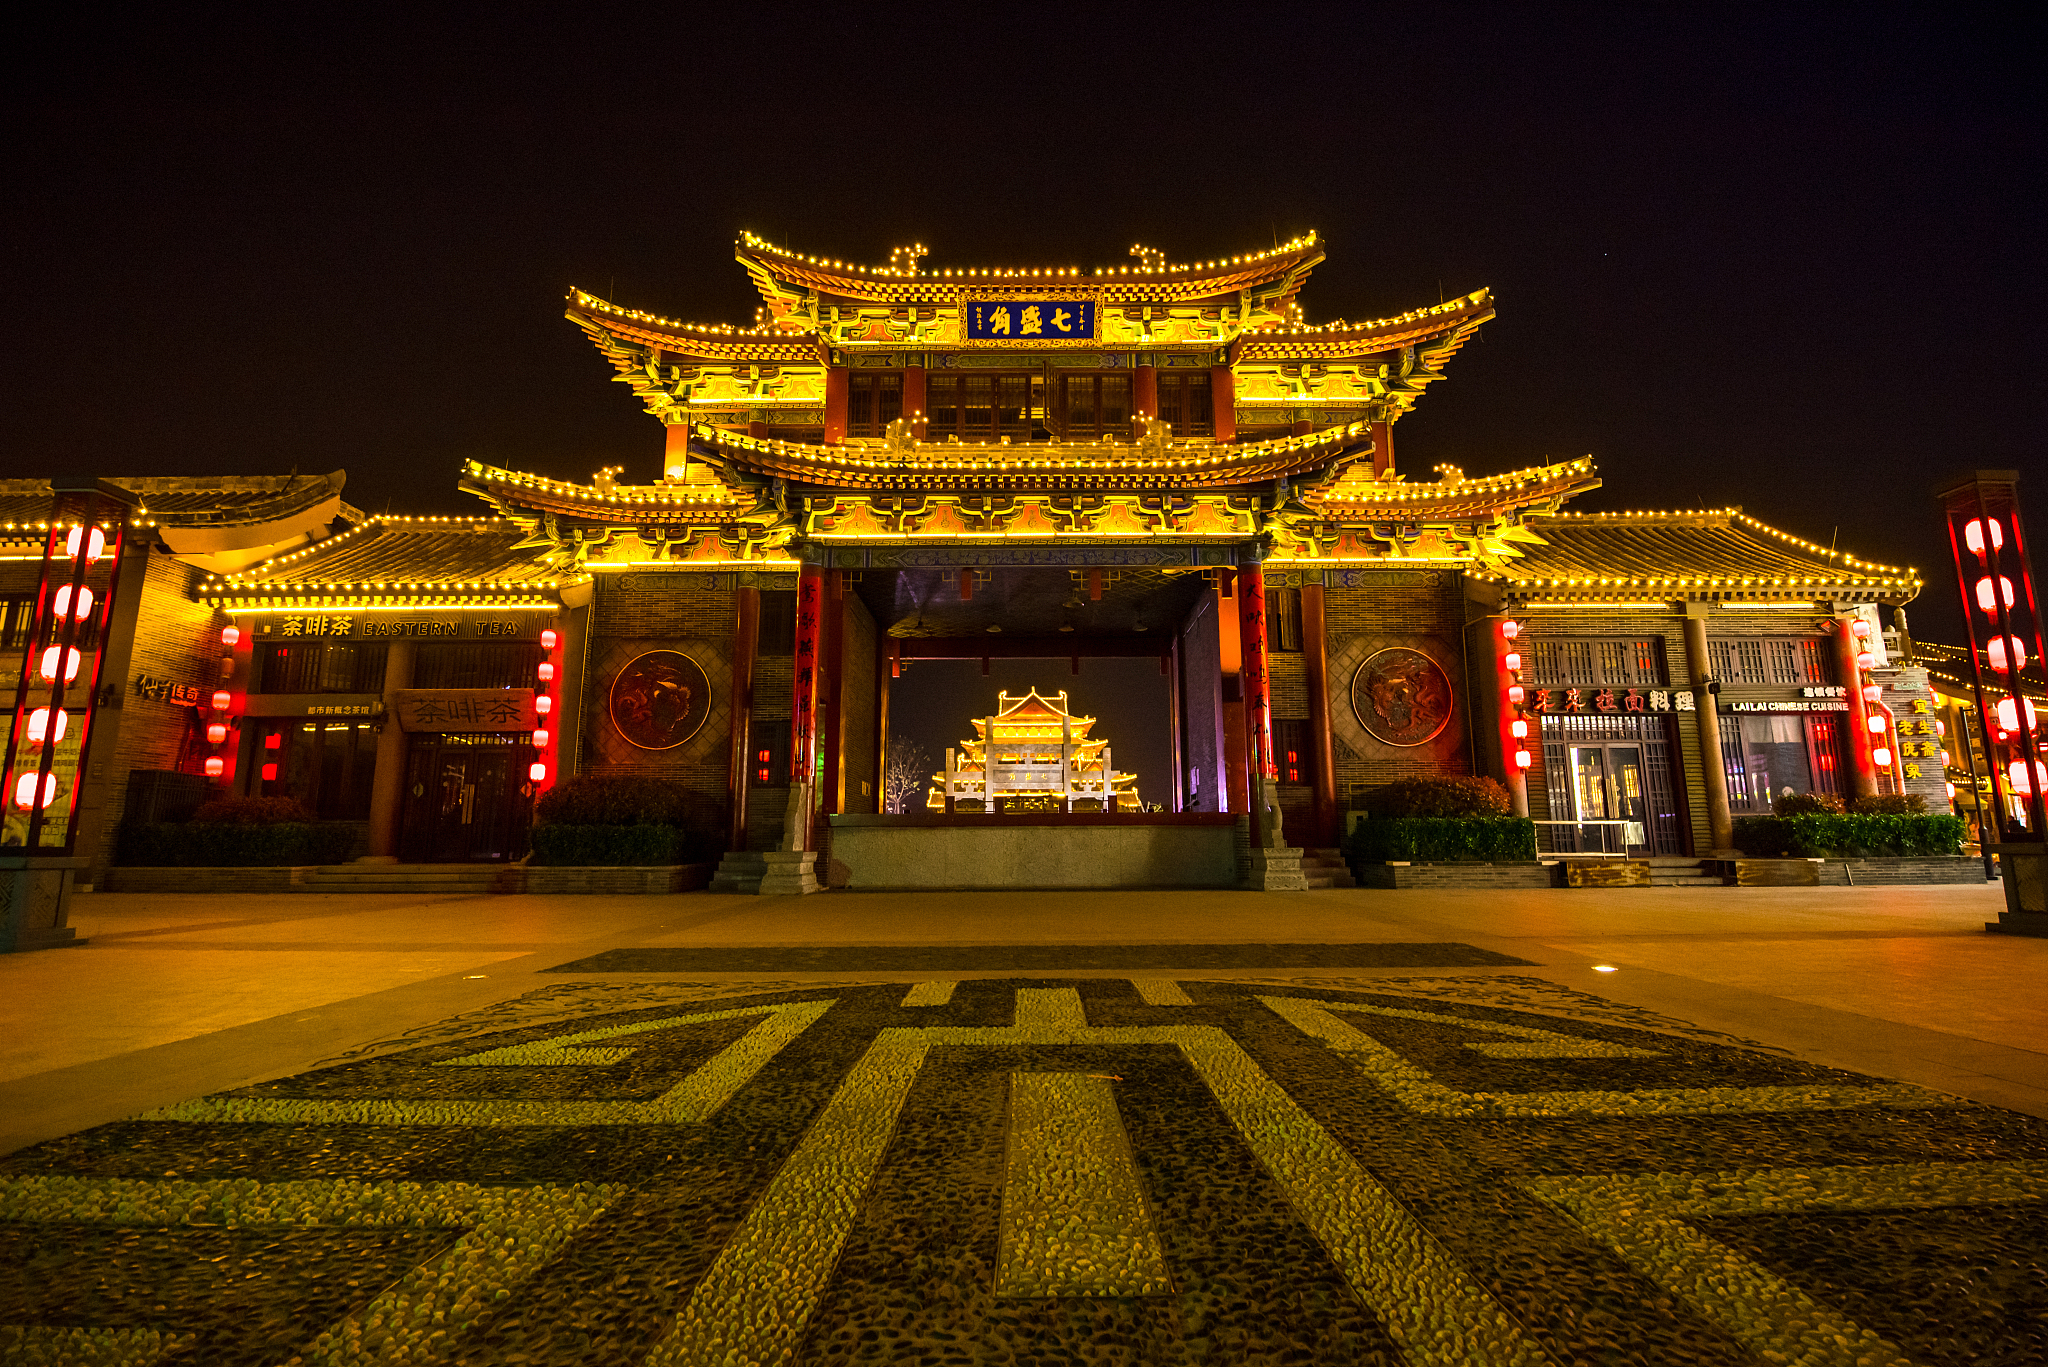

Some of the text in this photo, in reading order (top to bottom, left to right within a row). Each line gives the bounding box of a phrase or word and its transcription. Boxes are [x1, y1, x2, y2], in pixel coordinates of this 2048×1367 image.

[363, 621, 516, 636] EASTERN TEA
[307, 705, 370, 715] 都市新概念茶馆
[1768, 702, 1809, 712] CHINESE
[1811, 702, 1849, 711] CUISINE
